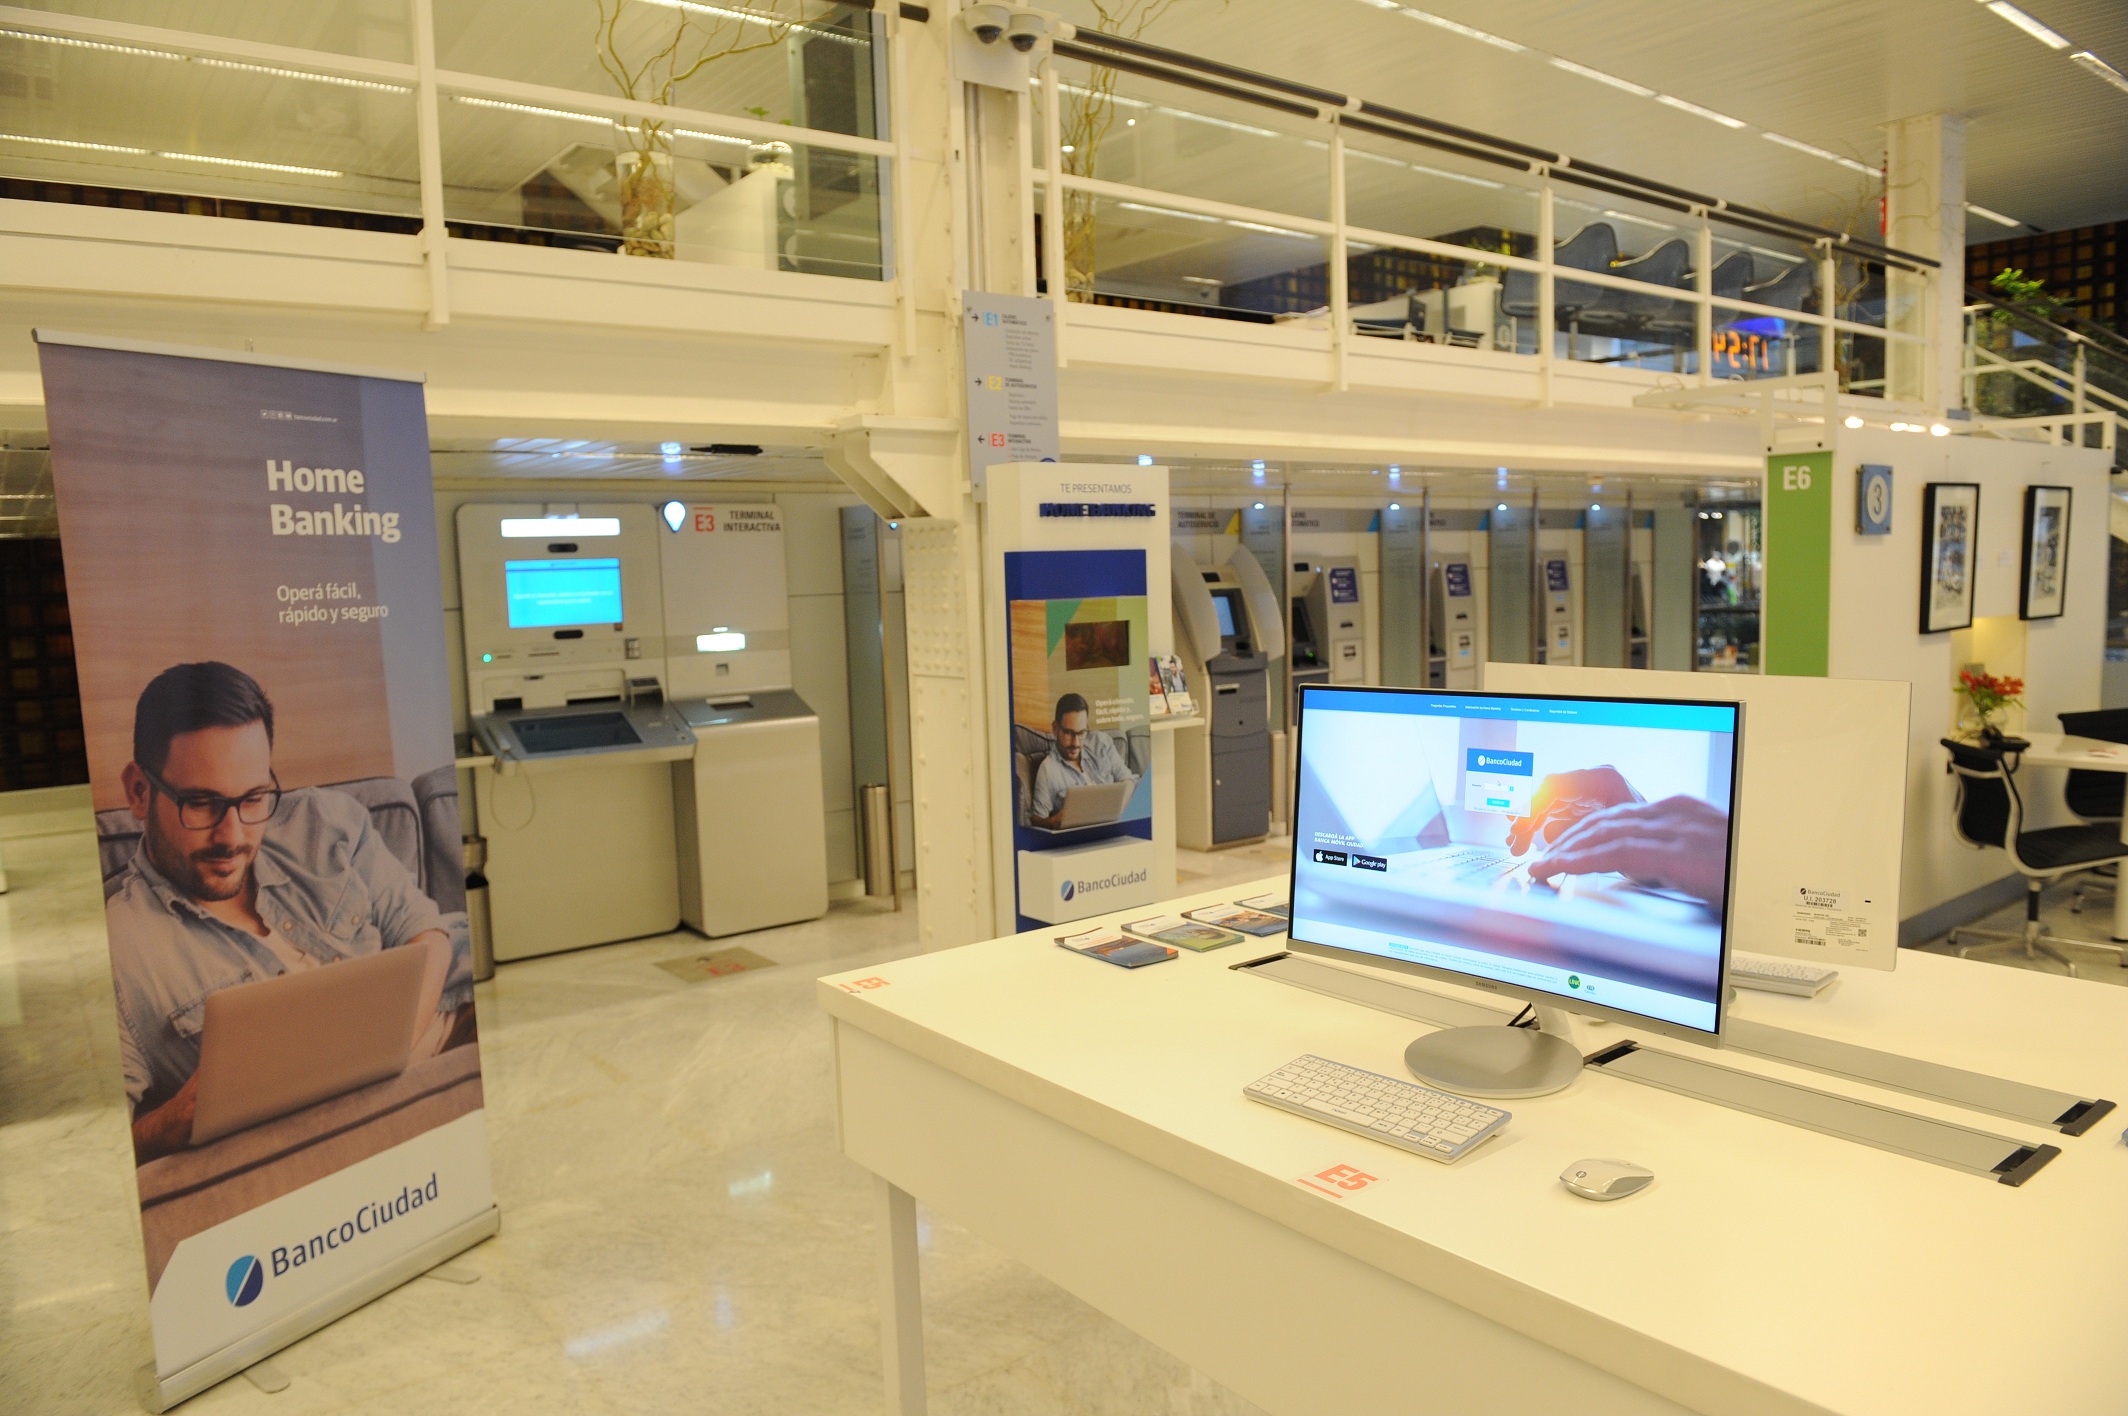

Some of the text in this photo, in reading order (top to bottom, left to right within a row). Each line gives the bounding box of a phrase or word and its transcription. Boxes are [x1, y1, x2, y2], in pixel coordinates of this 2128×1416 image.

[991, 433, 1005, 447] E3
[266, 459, 365, 494] Home
[1782, 466, 1812, 491] E6
[1060, 483, 1132, 494] TE PRESENTAMOS
[1874, 483, 1882, 515] 3
[270, 503, 401, 543] Banking
[695, 514, 715, 532] E3
[729, 510, 774, 519] TERMINAL
[723, 522, 781, 532] INTERACTIVA
[276, 582, 362, 604] Operá fácil,
[278, 604, 389, 626] rápido y seguro
[1486, 757, 1522, 767] BancoCiudad
[1361, 859, 1377, 868] Google
[1077, 869, 1147, 894] BancoCiudad
[1807, 889, 1841, 898] BancoCiudad
[1815, 896, 1837, 904] 203728
[1475, 981, 1498, 990] SAMSUNG
[1314, 1163, 1380, 1191] E5
[270, 1172, 439, 1278] BancoCiudad
